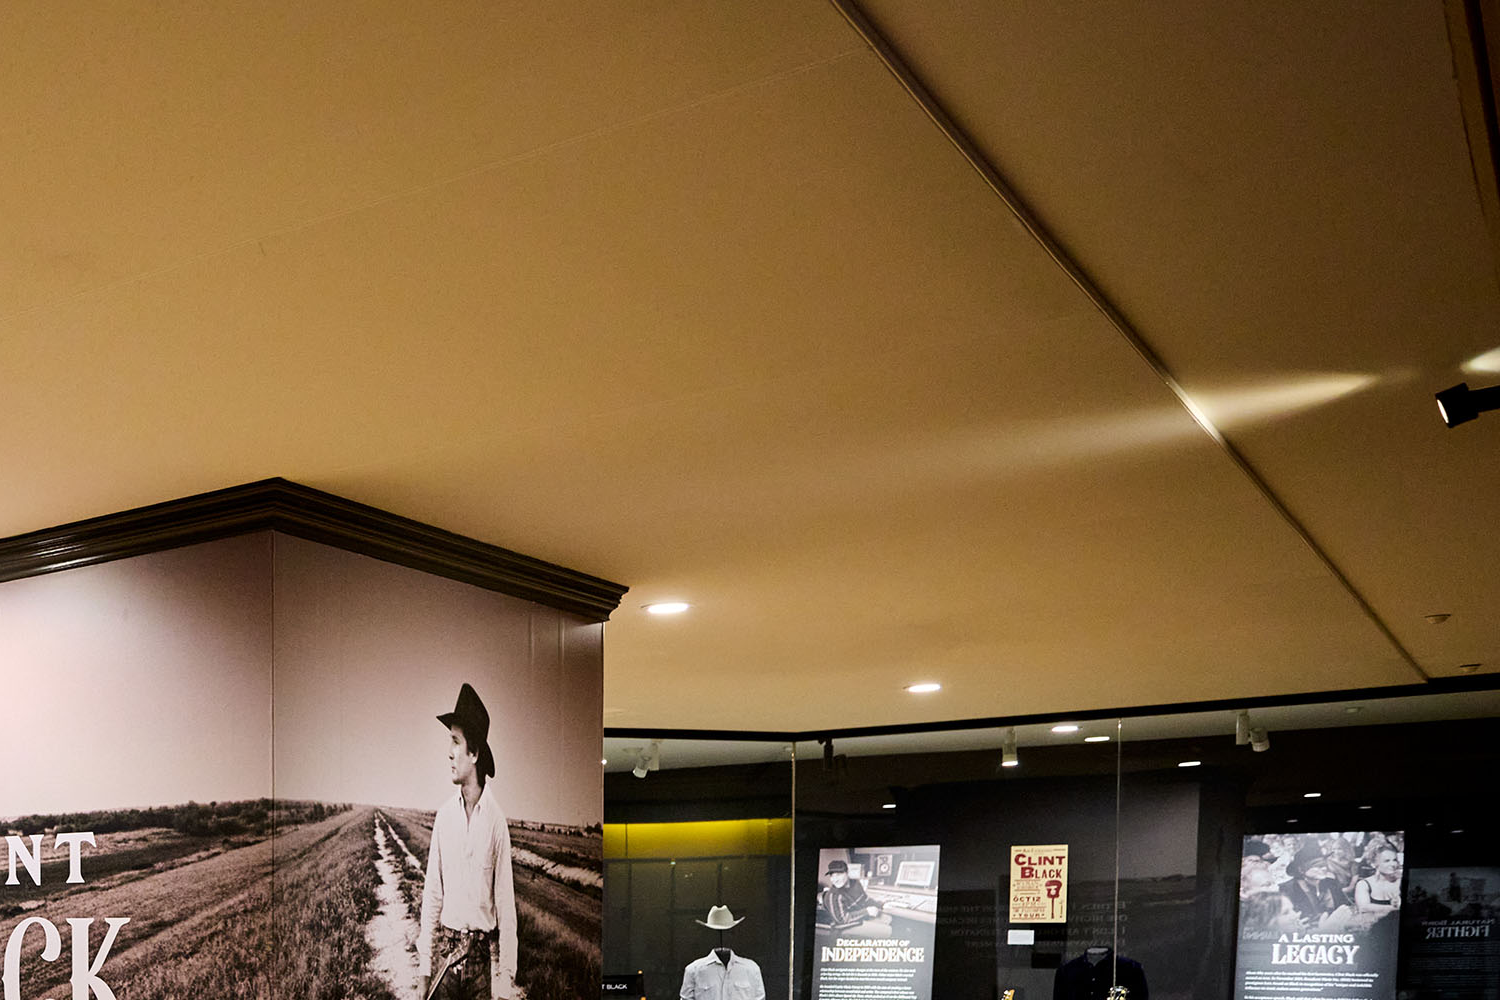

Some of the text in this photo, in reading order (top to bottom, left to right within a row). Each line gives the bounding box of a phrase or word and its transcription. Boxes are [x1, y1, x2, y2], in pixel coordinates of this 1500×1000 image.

[1014, 853, 1066, 866] CLINT
[1021, 867, 1062, 879] BLACK
[836, 938, 898, 947] DECLARATION
[1278, 933, 1289, 943] A
[1292, 932, 1355, 944] LASTING
[821, 946, 925, 963] INDEPENDENCE
[1271, 943, 1360, 965] LEGACY
